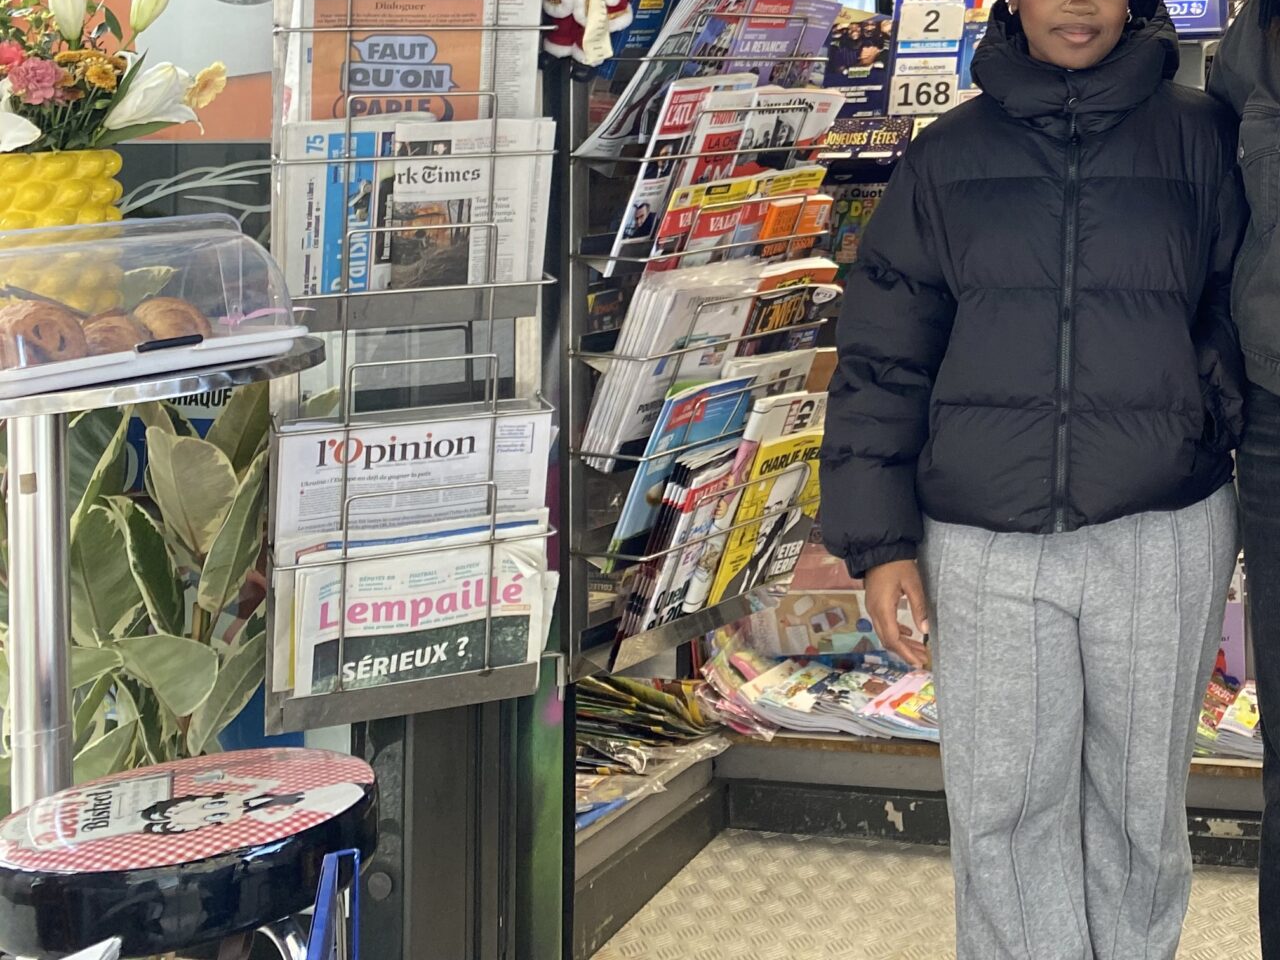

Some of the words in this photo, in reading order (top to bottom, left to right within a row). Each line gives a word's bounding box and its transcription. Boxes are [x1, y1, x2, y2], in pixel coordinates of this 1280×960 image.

[923, 9, 941, 33] 2
[367, 42, 430, 60] FAUT
[350, 68, 445, 90] QU'ON
[896, 80, 952, 108] 168
[824, 130, 868, 147] JOYEUSES
[422, 164, 481, 184] Times
[316, 432, 477, 470] l'Opinion
[759, 451, 801, 476] CHARLIE
[342, 642, 448, 683] SÉRIEUX
[456, 636, 469, 657] ?
